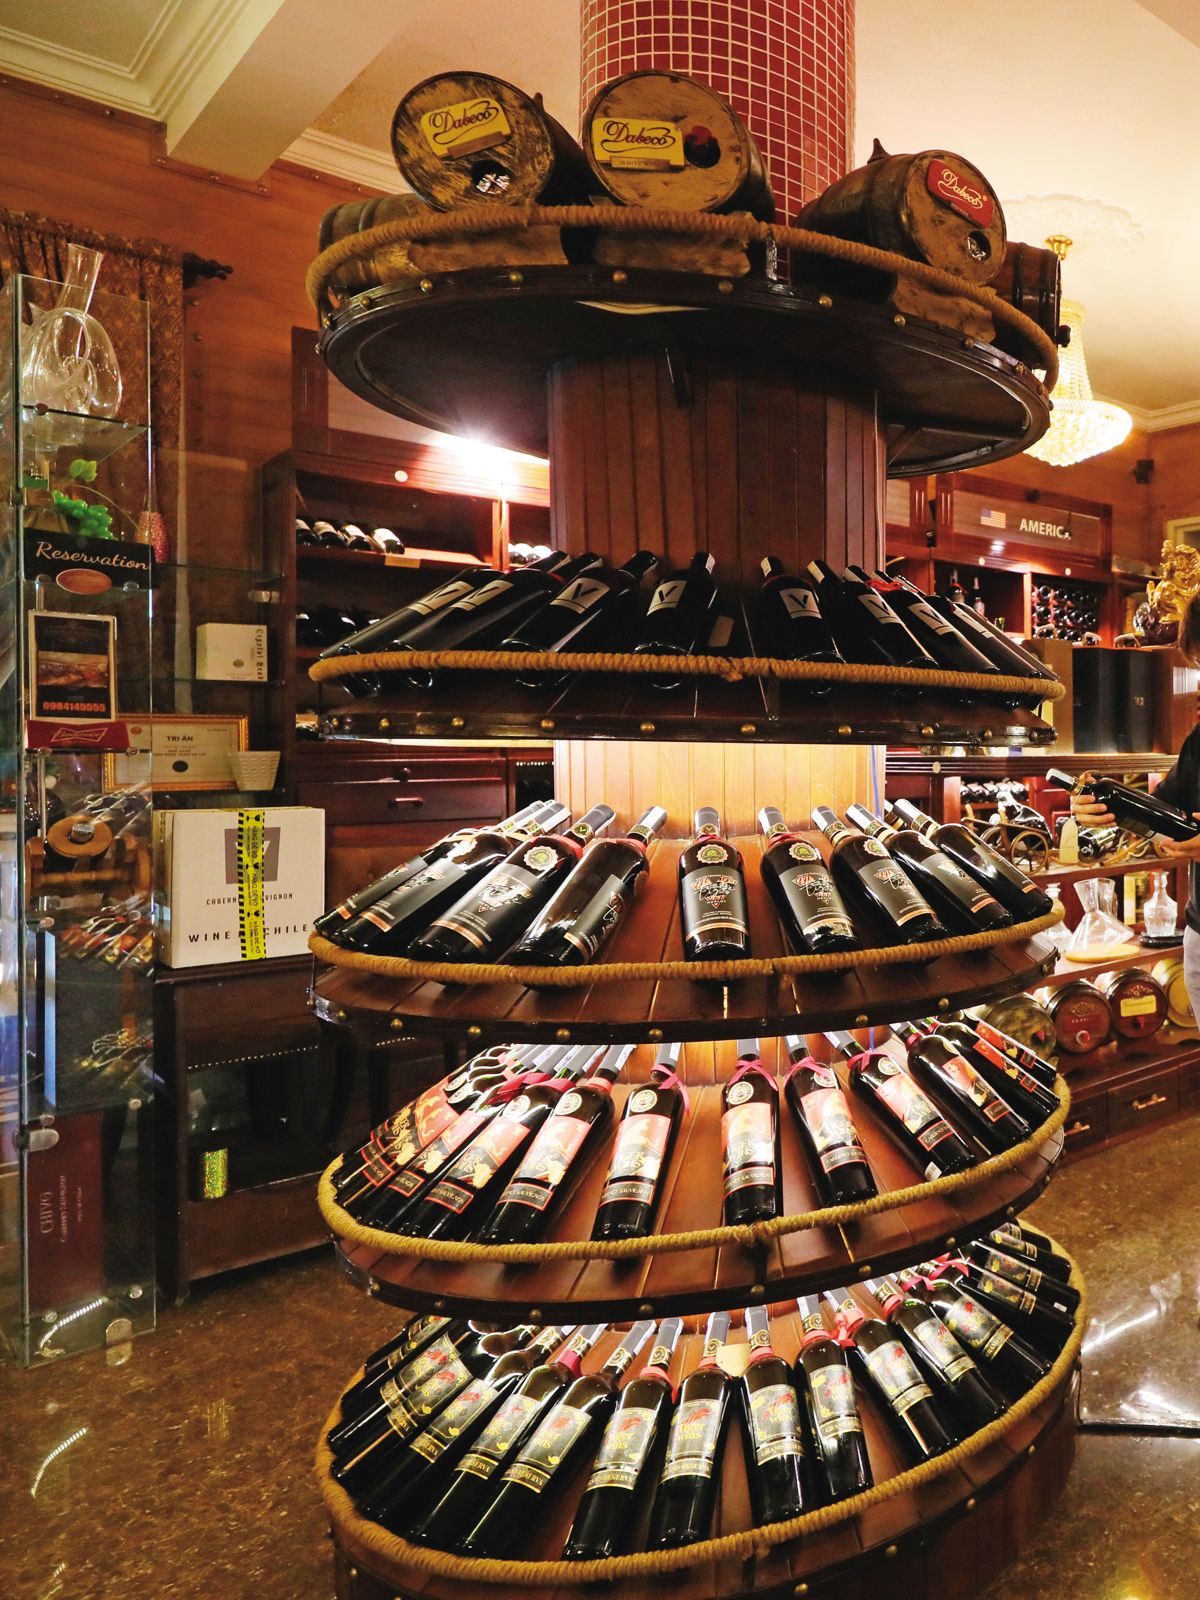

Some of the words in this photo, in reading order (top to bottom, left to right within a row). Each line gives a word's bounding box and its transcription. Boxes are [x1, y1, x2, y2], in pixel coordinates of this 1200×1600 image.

[428, 101, 498, 139] Dabeco
[600, 120, 674, 149] Dabeco
[939, 169, 982, 208] Dabeco
[35, 541, 150, 570] Reservation
[188, 930, 232, 943] WINE
